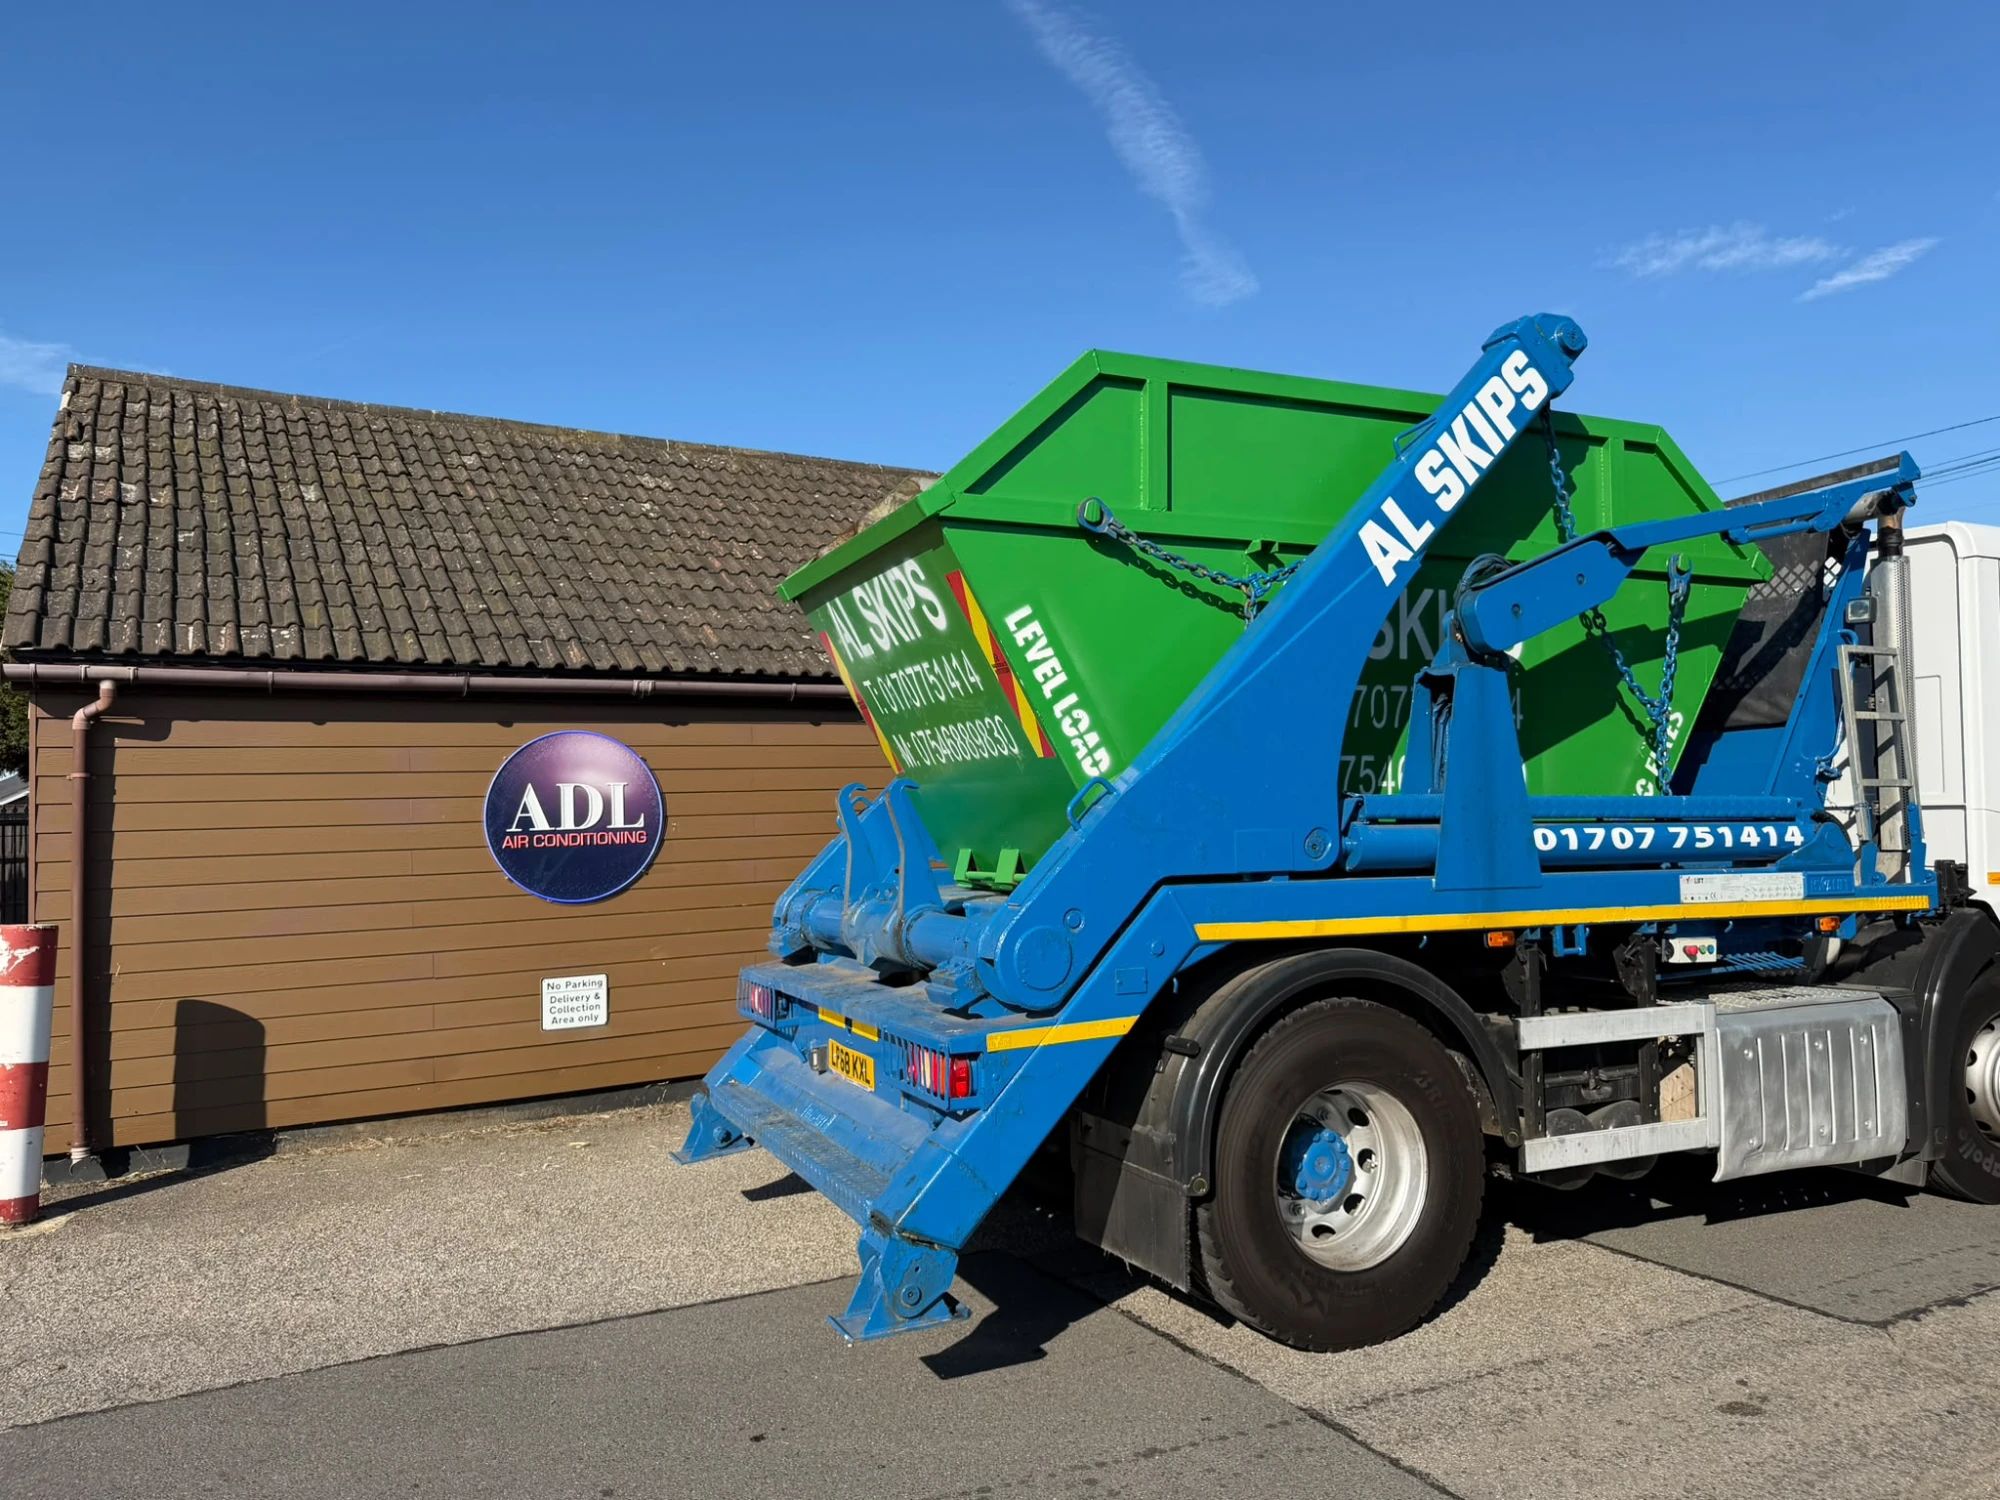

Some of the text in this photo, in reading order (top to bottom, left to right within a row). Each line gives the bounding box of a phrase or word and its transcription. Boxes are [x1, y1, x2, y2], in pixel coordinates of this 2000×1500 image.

[1358, 496, 1435, 587] AL
[1414, 350, 1549, 512] SKIPS
[825, 557, 948, 662] AL SKIPS
[1004, 604, 1112, 778] LEVEL LOAD
[506, 782, 645, 832] ADL
[502, 830, 648, 849] AIR CONDITIONING
[1533, 825, 1804, 851] 01707 751414
[546, 979, 603, 990] No Parking
[549, 1003, 601, 1015] Collection
[550, 992, 600, 1004] Delivery &
[552, 1013, 599, 1024] Area only
